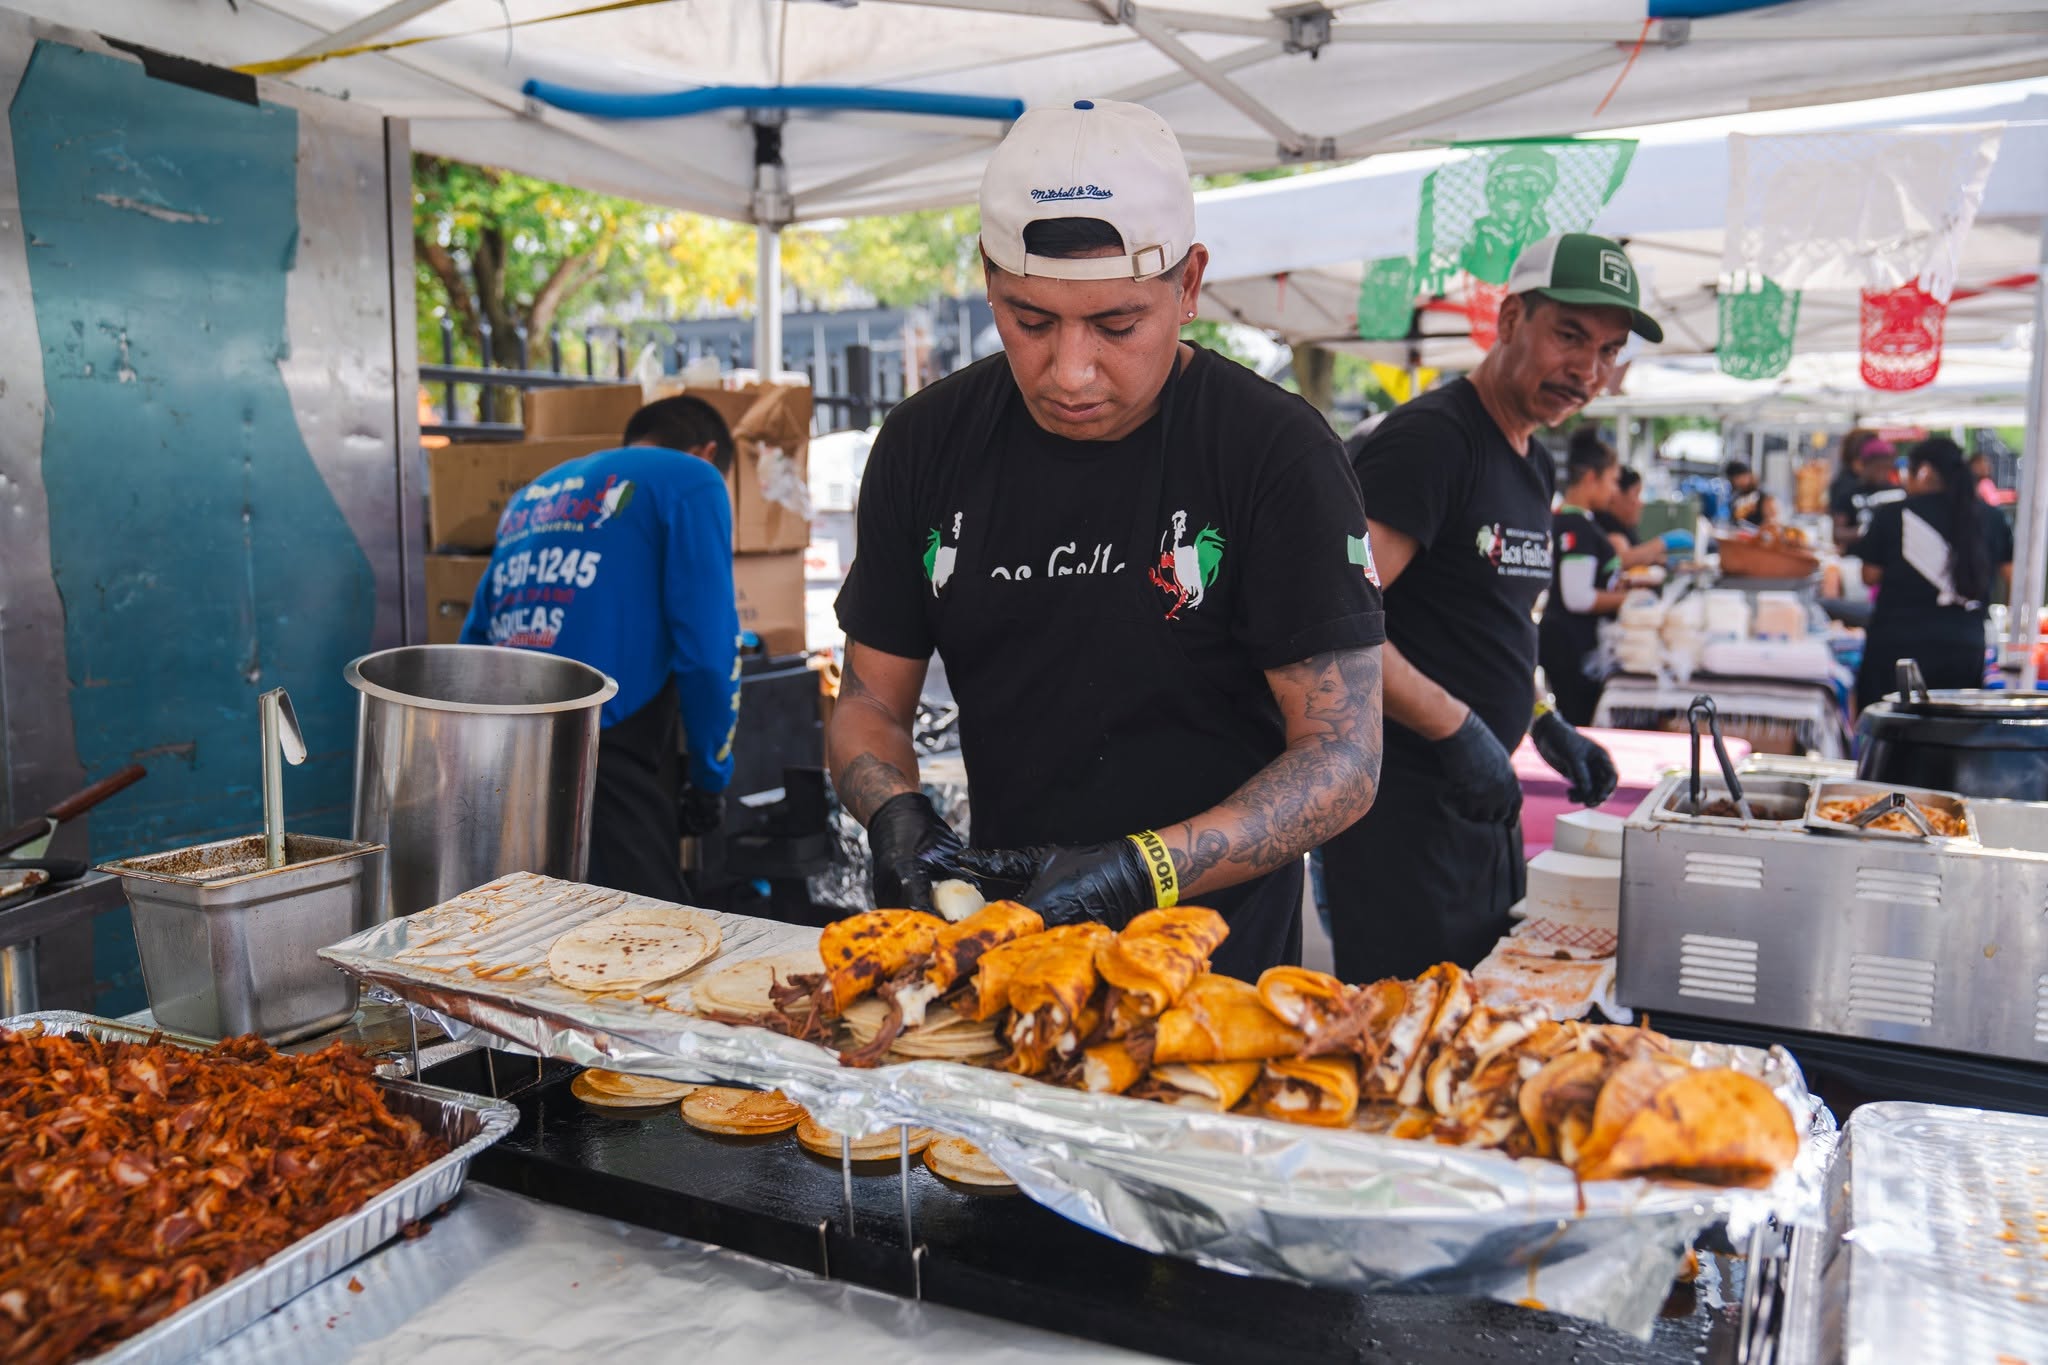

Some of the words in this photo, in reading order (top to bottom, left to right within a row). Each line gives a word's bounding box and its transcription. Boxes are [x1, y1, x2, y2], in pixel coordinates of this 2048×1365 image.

[1031, 186, 1076, 200] Mitchell
[1077, 185, 1085, 196] &
[1086, 184, 1113, 198] Ness
